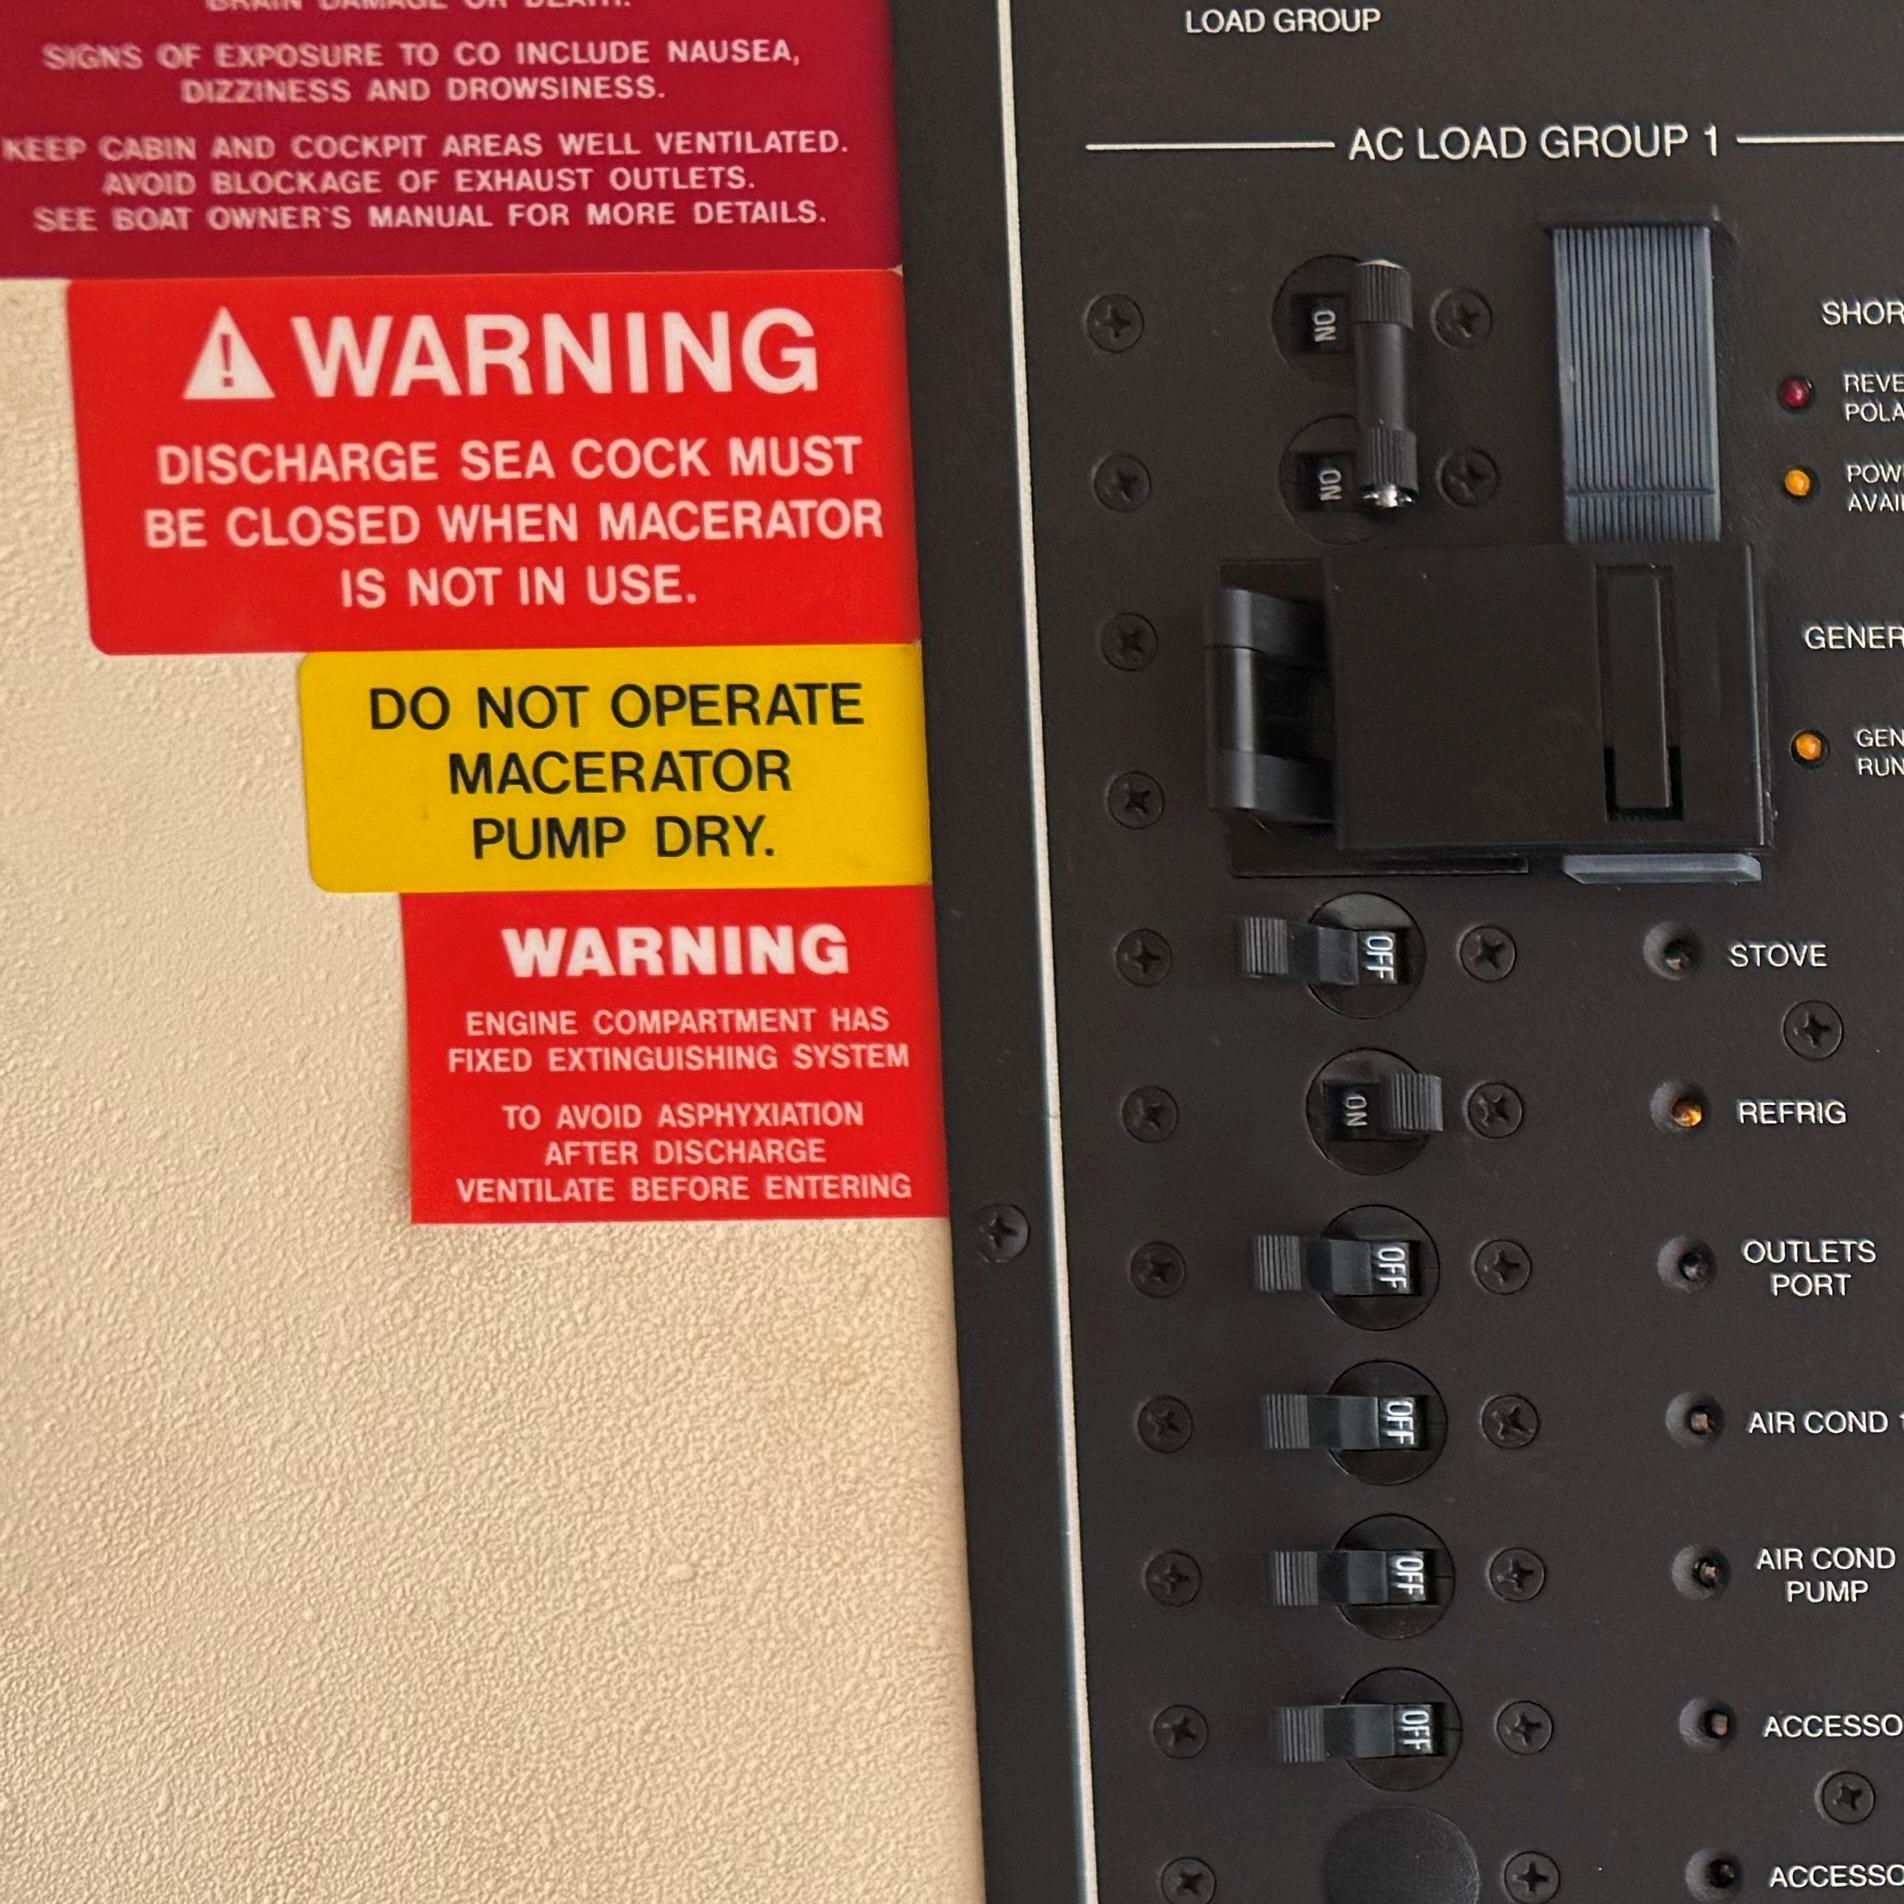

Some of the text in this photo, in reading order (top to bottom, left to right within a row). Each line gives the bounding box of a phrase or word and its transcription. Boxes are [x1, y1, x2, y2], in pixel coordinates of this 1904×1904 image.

[1185, 7, 1381, 33] LOAD GROUP
[43, 38, 800, 70] SIGNS OF EXPOSURE TO CO INCLUDE NAUSEA,
[181, 74, 665, 104] DIZZINESS AND DROWSINESS.
[1348, 123, 1717, 161] AC LOAD GROUP 1
[103, 165, 755, 197] AVOID BLOCKAGE OF EXHAUST OUTLETS.
[291, 307, 818, 398] WARNING
[157, 434, 863, 485] DISCHARGE SEA COCK MUST
[144, 498, 883, 549] BE CLOSED WHEN MACERATOR
[341, 563, 696, 609] IS NOT IN USE.
[369, 682, 864, 731] DO NOT OPERATE
[448, 748, 791, 795] MACERATOR
[472, 814, 774, 861] PUMP DRY.
[501, 923, 849, 978] WARNING
[1363, 934, 1396, 982] OFF
[1730, 943, 1827, 968] STOVE
[466, 1006, 889, 1037] ENGINE COMPARTMENT HAS
[448, 1043, 909, 1073] FIXED EXTINGUISHING SYSTEM
[1738, 1100, 1846, 1125] REFRIG
[544, 1138, 826, 1166] AFTER DISCHARGE
[1748, 1411, 1796, 1434] AIR
[1803, 1410, 1889, 1434] COND
